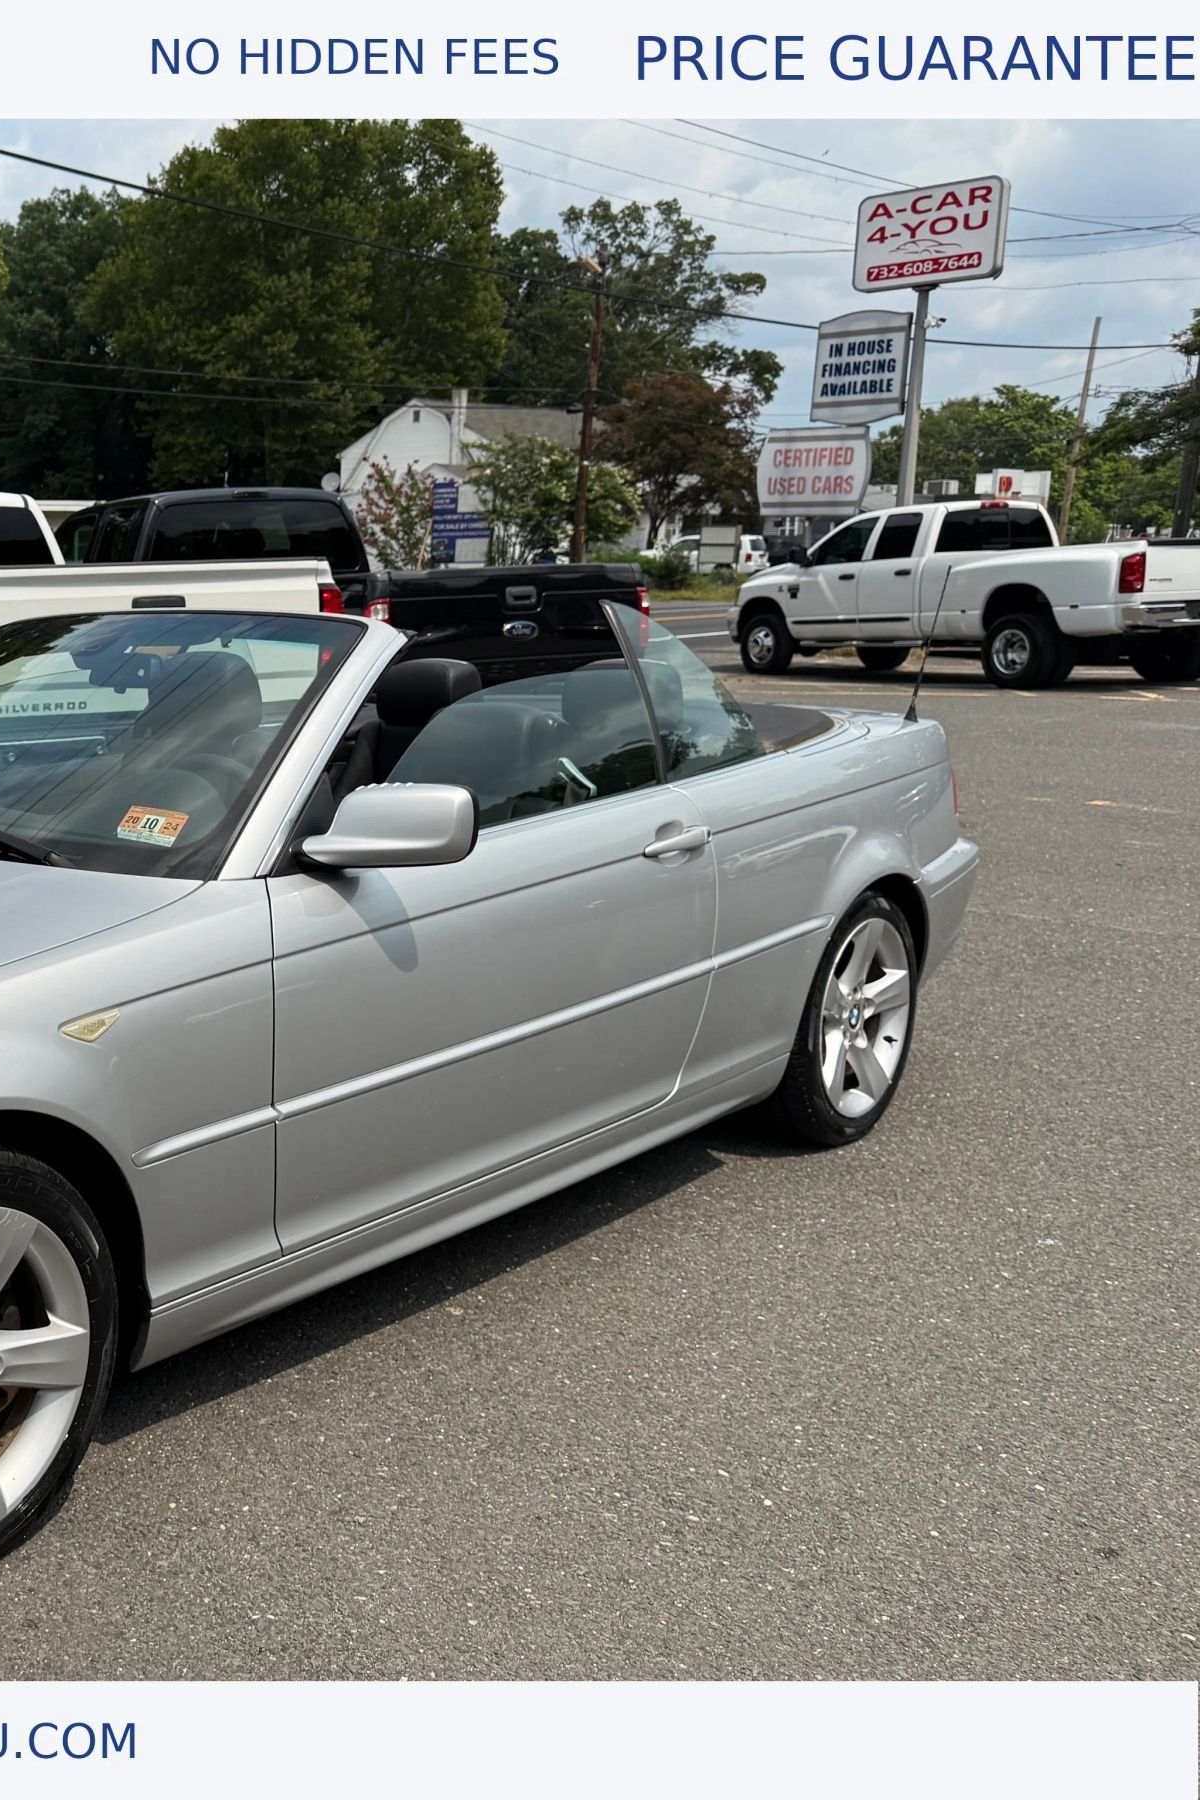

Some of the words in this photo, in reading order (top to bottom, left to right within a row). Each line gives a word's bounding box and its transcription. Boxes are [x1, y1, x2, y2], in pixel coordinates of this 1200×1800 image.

[867, 185, 993, 222] A-CAR
[867, 210, 989, 244] 4-YOU
[869, 253, 980, 280] 732-608-7644
[829, 343, 843, 358] IN
[847, 339, 893, 357] HOUSE
[821, 358, 896, 378] FINANCING
[820, 378, 893, 397] AVAILABLE
[773, 446, 855, 469] CERTIFIED
[767, 476, 806, 496] USED
[811, 475, 854, 495] CARS
[125, 815, 140, 825] 20
[140, 817, 160, 830] 10
[163, 822, 180, 832] 24
